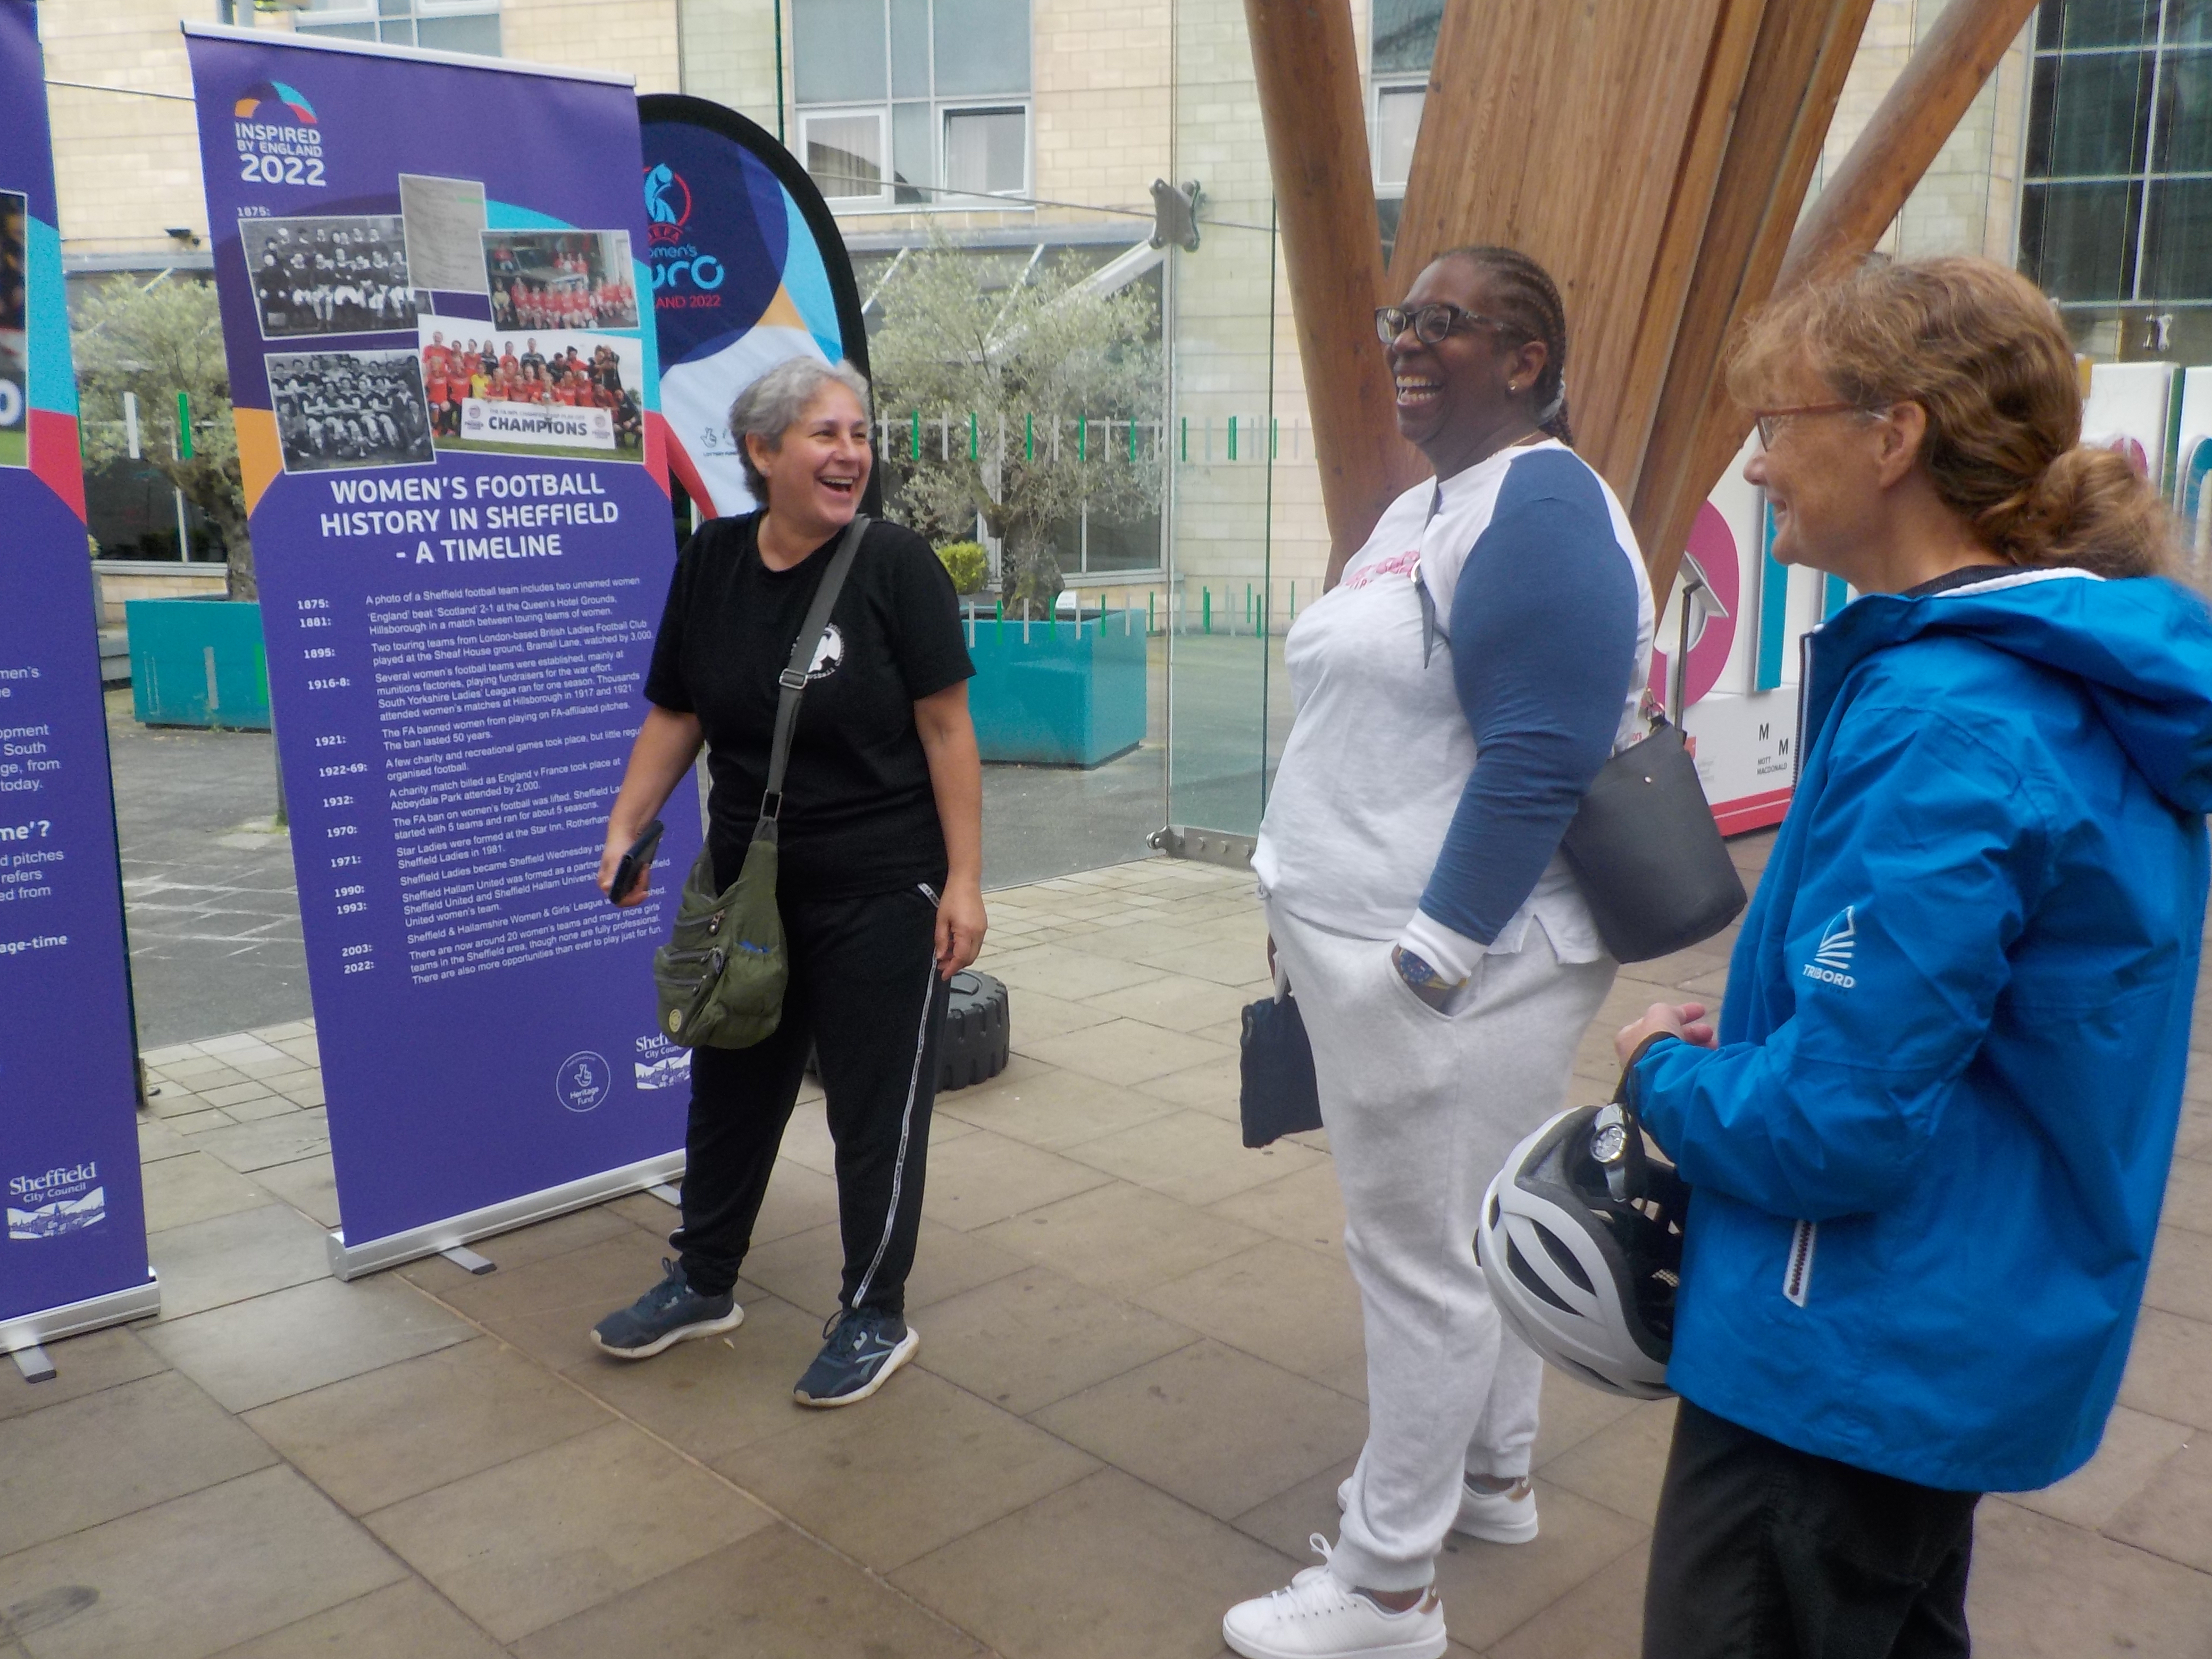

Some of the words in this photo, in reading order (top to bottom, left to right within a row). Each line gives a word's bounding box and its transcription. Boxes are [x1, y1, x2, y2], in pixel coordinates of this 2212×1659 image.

[235, 122, 320, 144] INSPIRED
[237, 139, 253, 152] BY
[259, 141, 323, 157] ENGLAND
[240, 153, 326, 186] 2022
[690, 295, 721, 307] 2022
[488, 416, 588, 436] CHAMPIONS
[330, 476, 467, 504] WOMEN'S
[476, 473, 605, 498] FOOTBALL
[321, 508, 440, 537] HISTORY
[450, 507, 477, 531] IN
[486, 502, 618, 529] SHEFFIELD
[416, 541, 434, 564] A
[440, 534, 562, 562] TIMELINE
[297, 599, 329, 610] 1875:
[412, 609, 433, 619] beat
[480, 604, 493, 614] 2-1
[496, 603, 505, 612] at
[506, 602, 519, 611] the
[557, 597, 579, 607] Hotel
[300, 617, 331, 628] 1881:
[371, 643, 391, 652] Two
[392, 640, 425, 651] touring
[427, 639, 455, 648] teams
[457, 635, 477, 644] from
[479, 630, 538, 643] London-based
[540, 627, 565, 638] British
[567, 625, 594, 635] Ladies
[596, 621, 627, 632] Football
[629, 619, 647, 629] Club
[304, 648, 336, 659] 1895:
[307, 677, 350, 690] 1916-8:
[378, 697, 406, 708] South
[407, 693, 450, 705] Yorkshire
[485, 686, 516, 697] League
[533, 682, 544, 691] for
[597, 672, 640, 684] Thousands
[382, 728, 400, 738] The
[402, 726, 415, 736] FA
[417, 722, 451, 734] banned
[453, 719, 485, 730] women
[487, 716, 506, 725] from
[508, 713, 537, 725] playing
[551, 704, 599, 717] FA-affiliated
[1759, 723, 1769, 741] M
[4, 741, 46, 756] South
[315, 735, 346, 747] 1921:
[383, 741, 401, 751] The
[404, 739, 421, 749] ban
[423, 734, 451, 746] lasted
[453, 733, 464, 743] 50
[1779, 738, 1788, 756] M
[28, 759, 60, 771] from
[1758, 756, 1771, 766] MOTT
[320, 763, 367, 777] 1922-69:
[387, 766, 432, 782] organised
[1757, 763, 1787, 775] MACDONALD
[1, 778, 43, 791] today.
[389, 789, 397, 798] A
[398, 785, 428, 797] charity
[431, 781, 458, 792] match
[460, 776, 483, 788] billed
[498, 770, 532, 783] England
[540, 766, 568, 776] France
[570, 761, 588, 772] took
[589, 760, 610, 770] place
[613, 757, 621, 766] at
[323, 796, 354, 808] 1932:
[391, 796, 439, 810] Abbeydale
[440, 792, 462, 803] Park
[464, 786, 501, 800] attended
[503, 785, 513, 795] by
[327, 826, 357, 838] 1970:
[13, 850, 64, 867] pitches
[331, 856, 361, 868] 1971:
[398, 854, 437, 869] Sheffield
[439, 851, 469, 862] Ladies
[471, 849, 480, 857] in
[2, 870, 43, 883] refers
[19, 886, 51, 899] from
[334, 885, 365, 898] 1990:
[337, 902, 367, 915] 1993:
[405, 914, 434, 927] United
[409, 949, 436, 960] There
[438, 946, 452, 955] are
[455, 942, 473, 951] now
[475, 934, 505, 948] around
[507, 931, 518, 942] 20
[556, 920, 581, 931] teams
[583, 915, 598, 925] and
[599, 912, 621, 921] many
[622, 907, 642, 917] more
[341, 944, 373, 957] 2003:
[412, 974, 438, 984] There
[441, 970, 455, 979] are
[457, 966, 475, 975] also
[477, 961, 500, 971] more
[502, 950, 554, 967] opportunities
[555, 945, 573, 955] than
[575, 941, 592, 950] ever
[603, 935, 619, 946] play
[621, 931, 635, 942] just
[636, 928, 647, 937] for
[344, 961, 374, 974] 2022:
[1803, 964, 1855, 988] TRIBORD
[645, 1050, 659, 1059] City
[570, 1087, 599, 1099] Heritage
[578, 1096, 593, 1105] Fund
[10, 1161, 96, 1195] Sheffield
[23, 1193, 44, 1203] City
[47, 1182, 87, 1197] Council
